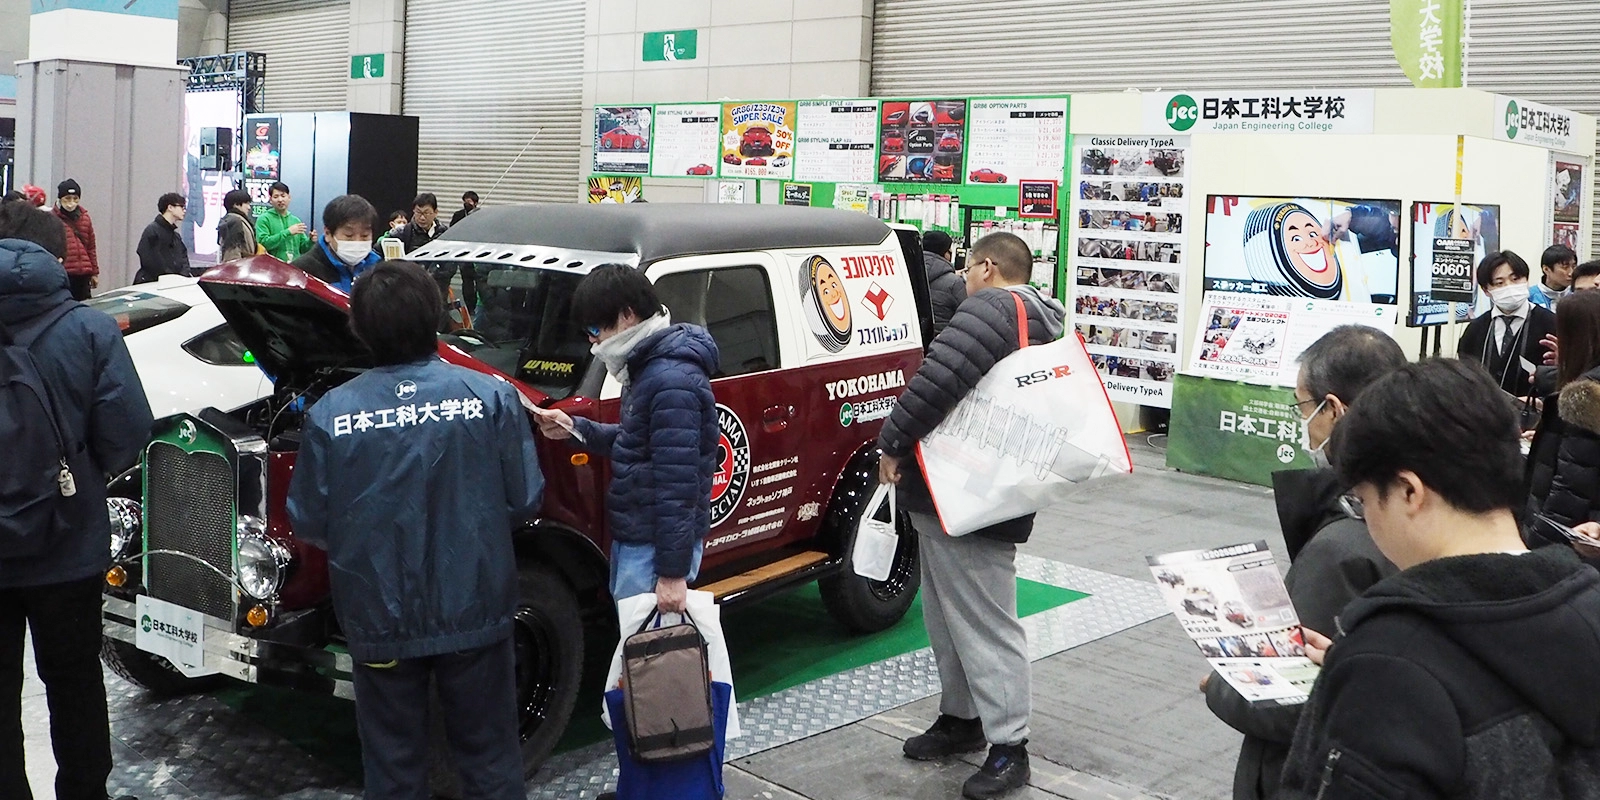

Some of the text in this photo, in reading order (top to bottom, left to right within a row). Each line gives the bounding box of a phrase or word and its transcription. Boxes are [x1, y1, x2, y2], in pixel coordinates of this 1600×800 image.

[731, 103, 786, 117] GR86/Z33/Z34
[1167, 101, 1198, 124] jec
[1203, 96, 1345, 119] 日本工科大学校
[733, 113, 783, 126] SUPER SALE
[1213, 121, 1333, 132] Japan Engineering College
[1506, 107, 1519, 131] jec
[1521, 107, 1571, 137] 日本工科大学校
[775, 140, 791, 151] OFF
[776, 129, 793, 141] 50%
[1091, 138, 1174, 147] Classic Delivery TypeA
[245, 183, 272, 204] TES
[841, 255, 895, 279] ヨコハマタイヤ
[1432, 263, 1471, 277] 60601
[857, 323, 909, 345] スマイルショップ
[541, 360, 574, 372] WORK
[396, 385, 416, 398] jec
[825, 369, 906, 400] YOKOHAMA
[1107, 381, 1163, 396] Delivery TypeA
[334, 398, 484, 436] 日本工科大学校
[1219, 410, 1304, 444] 日本工科
[1279, 447, 1293, 458] jec
[710, 475, 743, 520] ECIAL
[153, 618, 198, 644] 日本工科大学校
